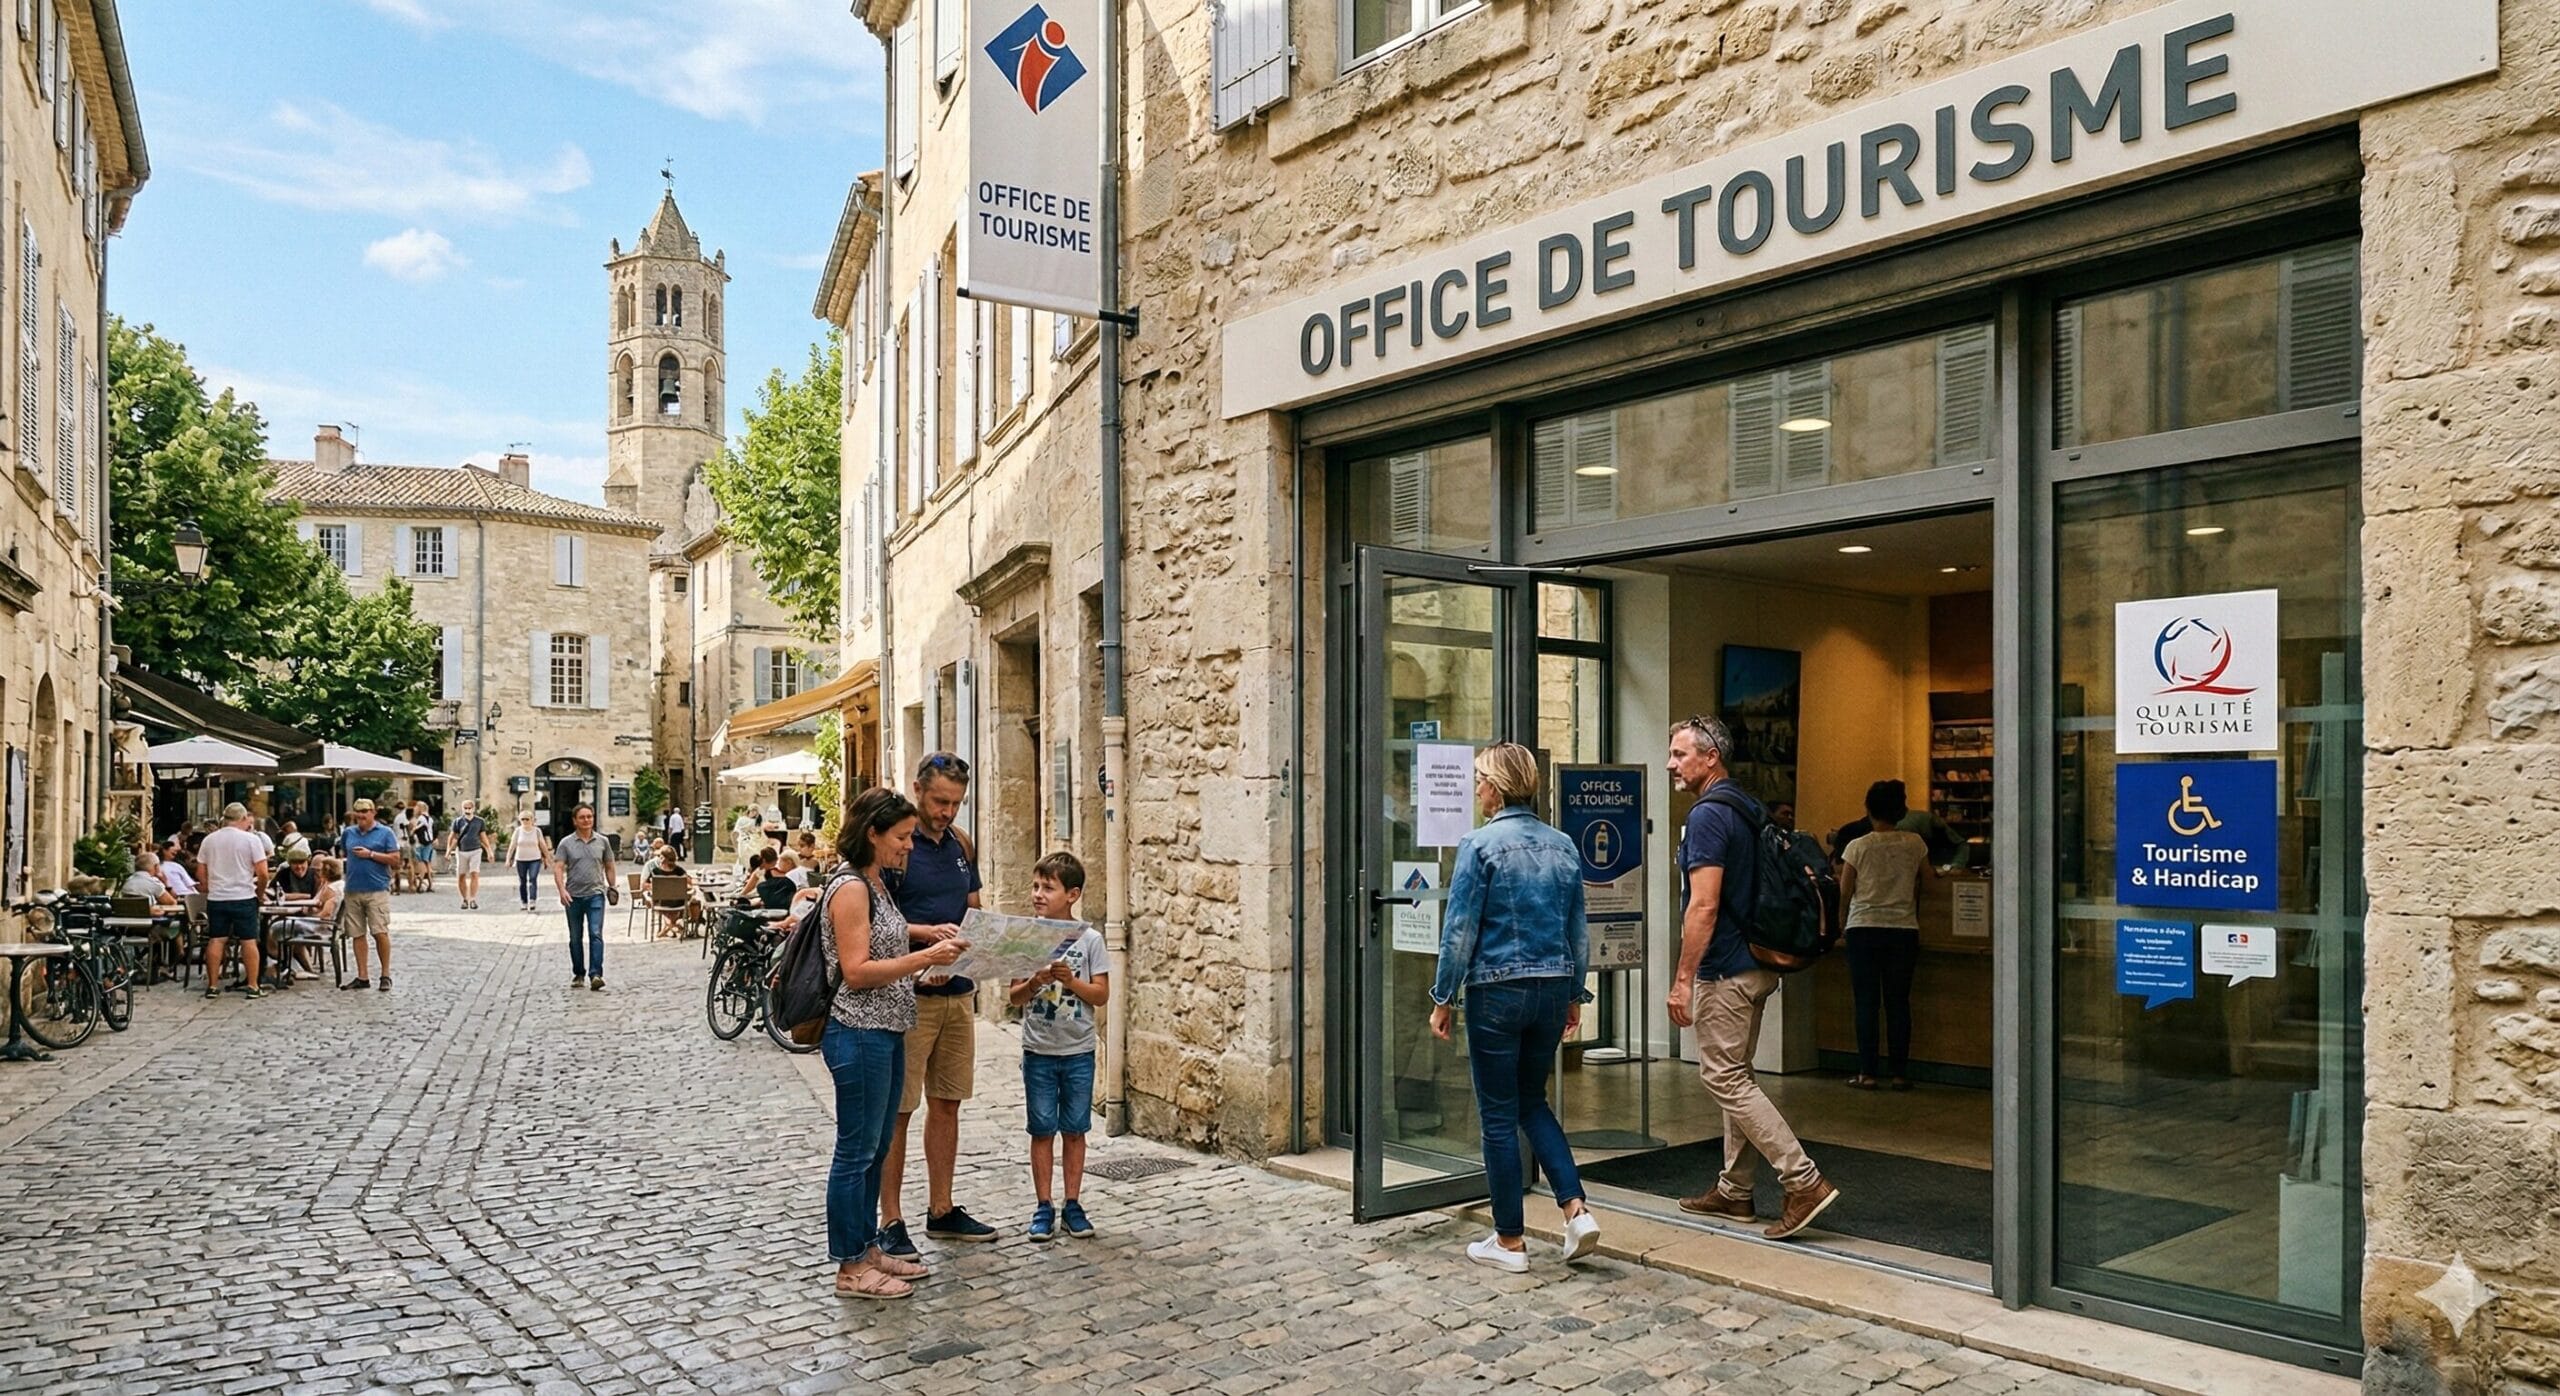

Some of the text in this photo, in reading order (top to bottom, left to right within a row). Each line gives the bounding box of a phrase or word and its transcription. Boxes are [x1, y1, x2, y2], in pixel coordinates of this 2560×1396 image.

[979, 181, 1091, 223] OFFICE DE
[1300, 12, 2238, 378] OFFICE DE TOURISME
[979, 211, 1091, 254] TOURISME
[2136, 698, 2253, 722] QUALITÉ
[2136, 719, 2254, 736] TOURISME
[1568, 794, 1635, 806] DE TOURISME
[2142, 843, 2248, 864] Tourisme
[2131, 867, 2259, 893] & Handicap
